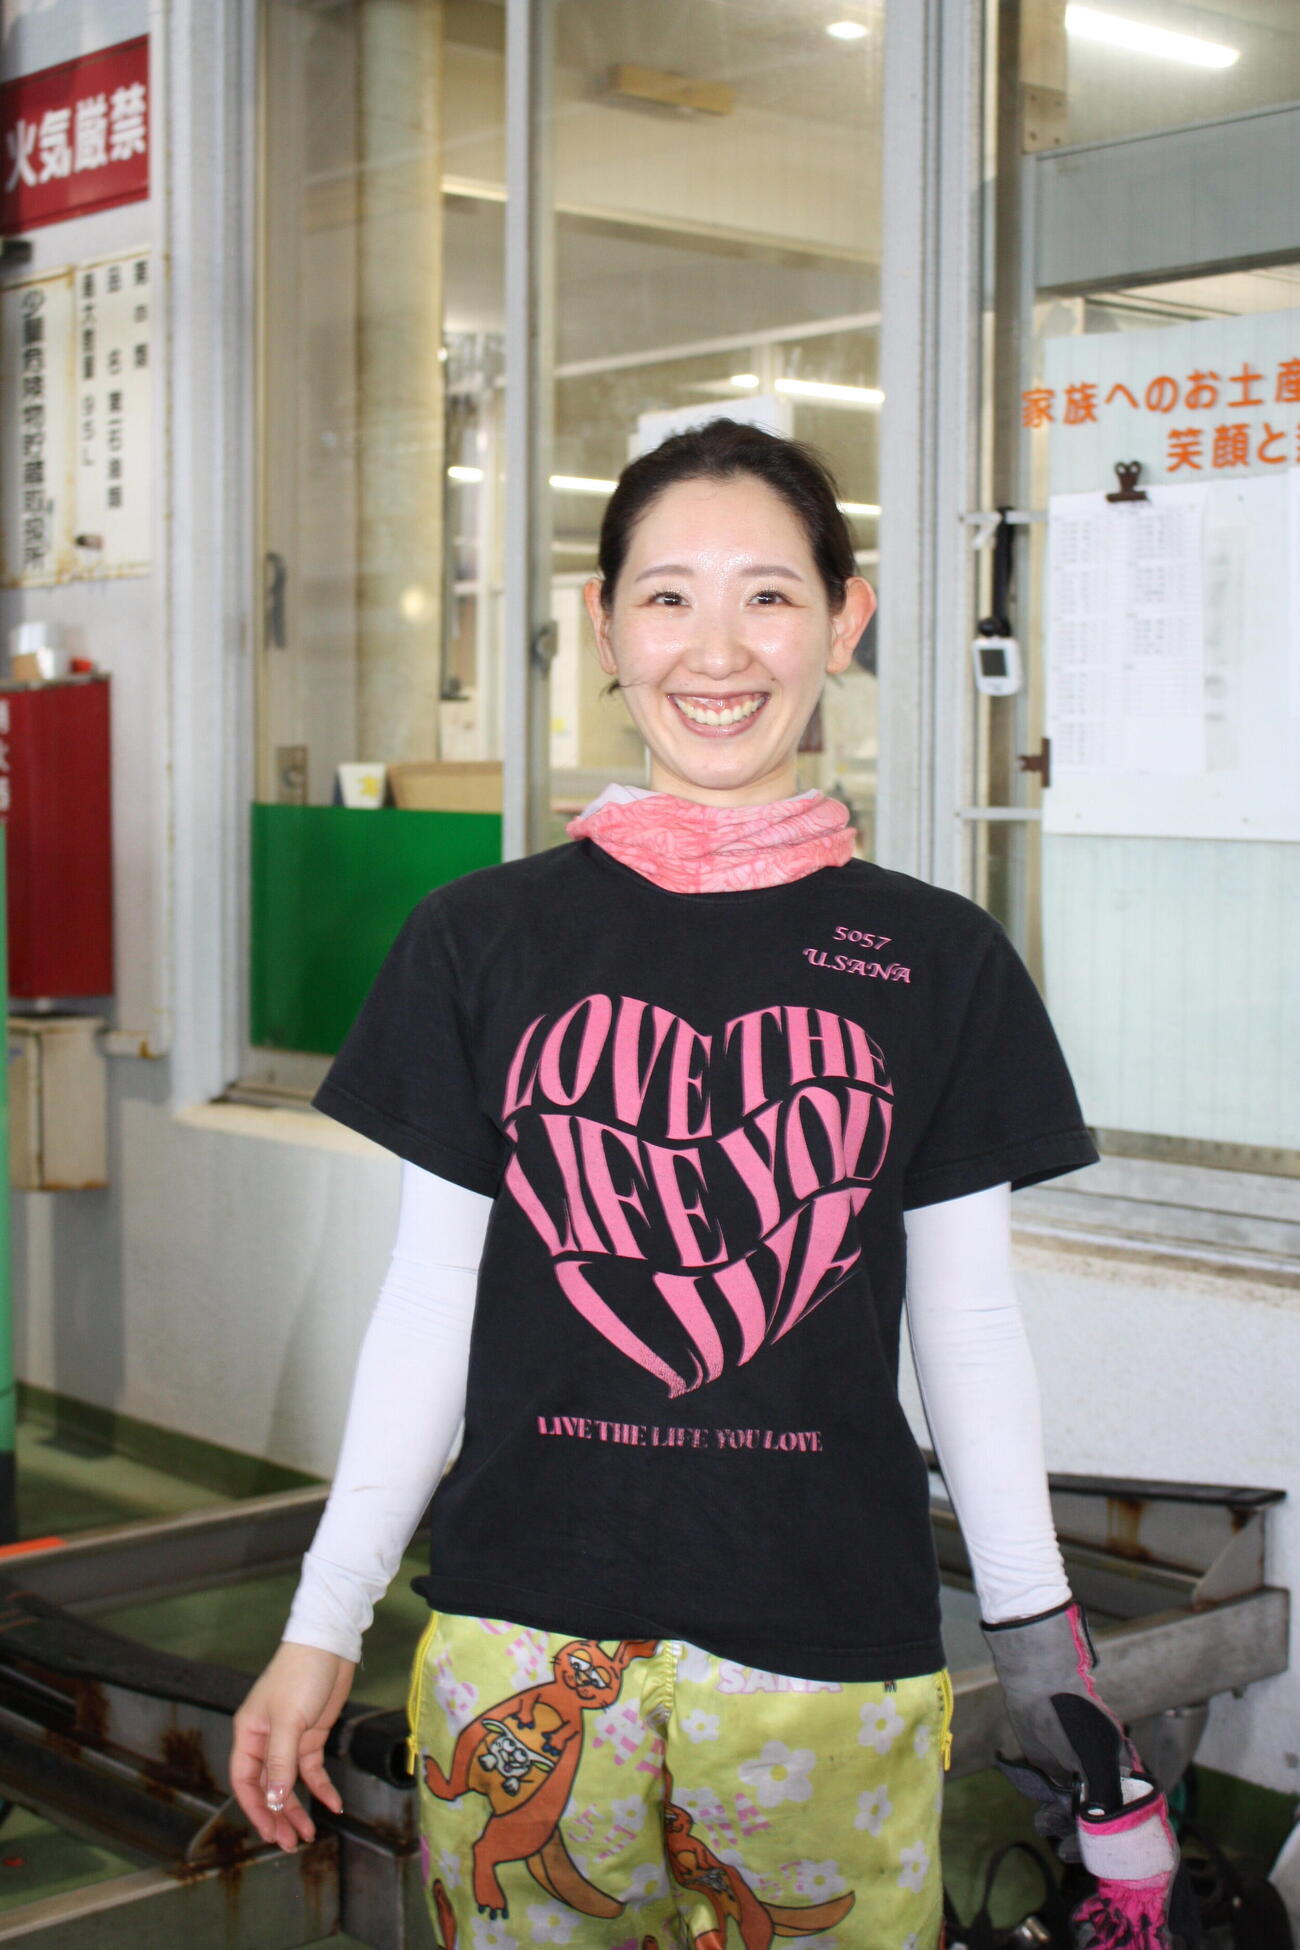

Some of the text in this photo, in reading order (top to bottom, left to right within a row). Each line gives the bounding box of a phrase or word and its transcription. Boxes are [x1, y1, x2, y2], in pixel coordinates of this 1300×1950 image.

[6, 82, 146, 193] 火気厳禁
[1166, 422, 1300, 473] 笑顔と
[802, 947, 911, 984] USANA
[832, 925, 893, 951] 5057
[502, 993, 894, 1140] LOVE THE
[503, 1085, 894, 1268] LIFE YOU
[553, 1187, 873, 1399] LIVE
[536, 1415, 823, 1453] LIVE THE LIFE YOU LOVE
